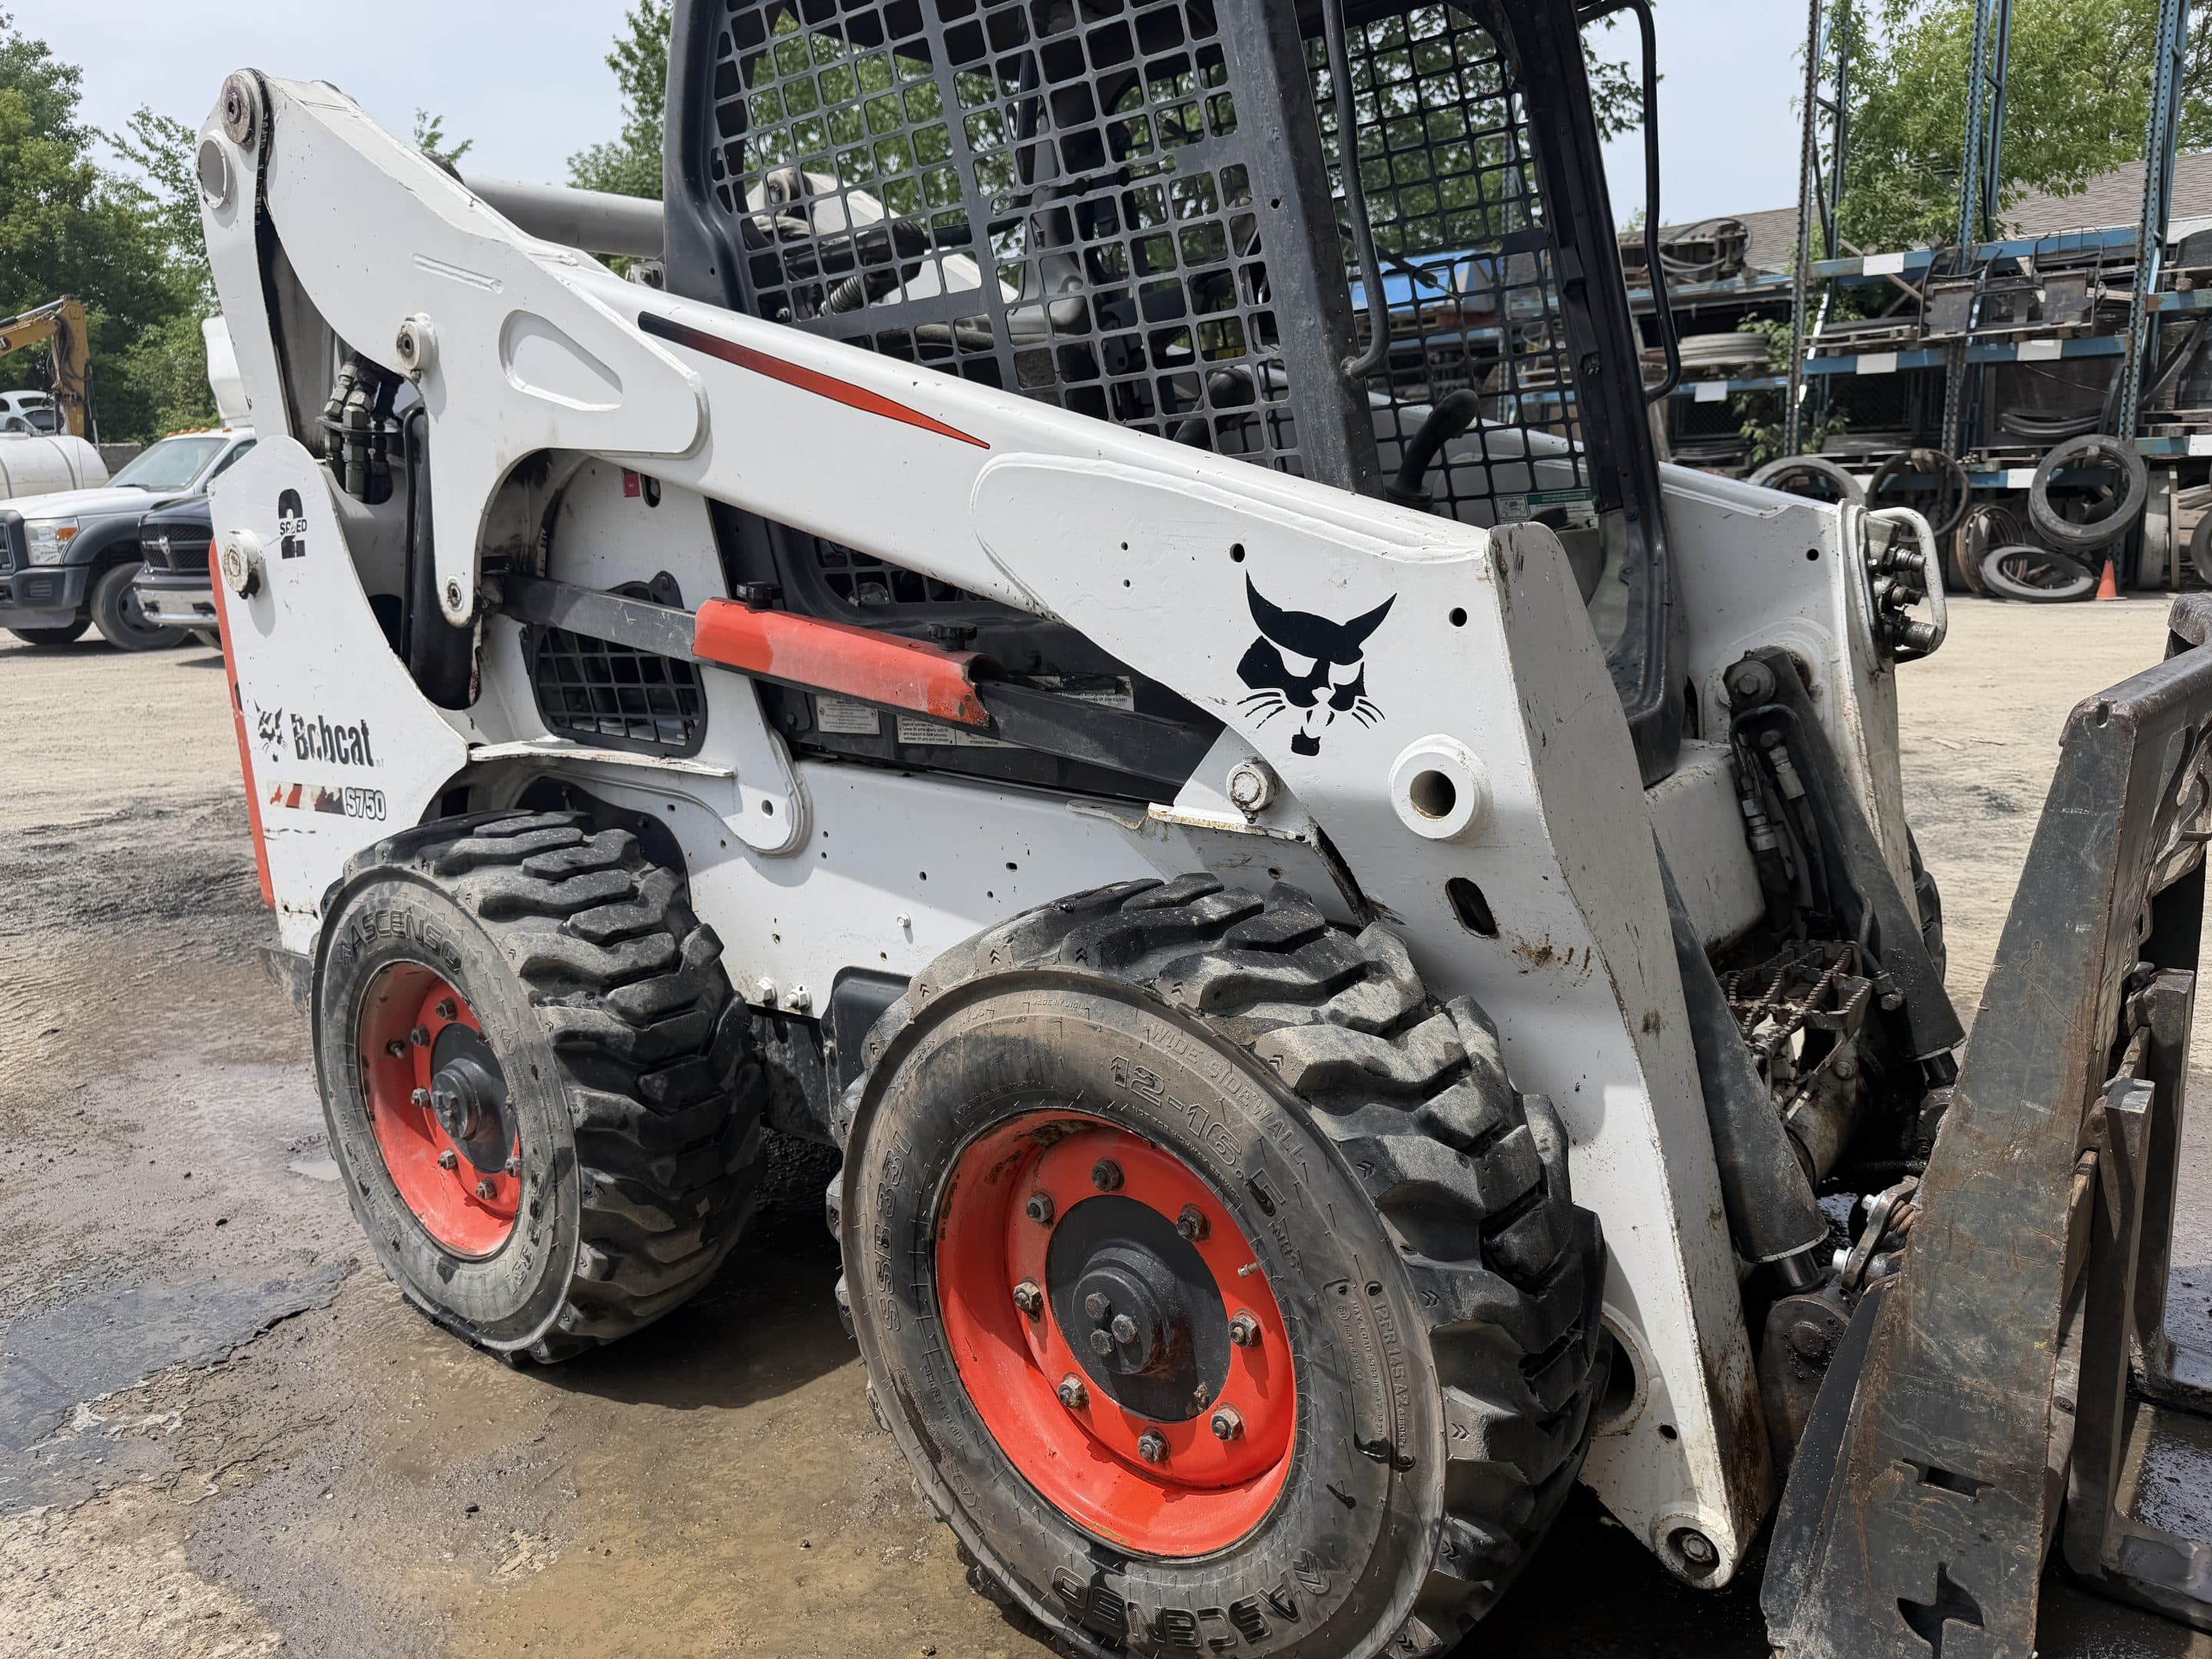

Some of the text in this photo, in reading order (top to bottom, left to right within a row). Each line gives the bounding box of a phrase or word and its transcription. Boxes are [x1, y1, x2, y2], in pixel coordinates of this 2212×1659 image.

[280, 519, 307, 536] SPED
[290, 713, 375, 767] Bobcat
[346, 786, 386, 821] S750
[351, 909, 462, 973] ASCENSO
[1151, 1024, 1305, 1167] WIDE SIDEWALL
[1111, 1055, 1286, 1217] 12-16.5
[874, 1129, 913, 1331] SSB 331
[1387, 1348, 1406, 1379] 145
[1052, 1565, 1301, 1650] ASCENSO
